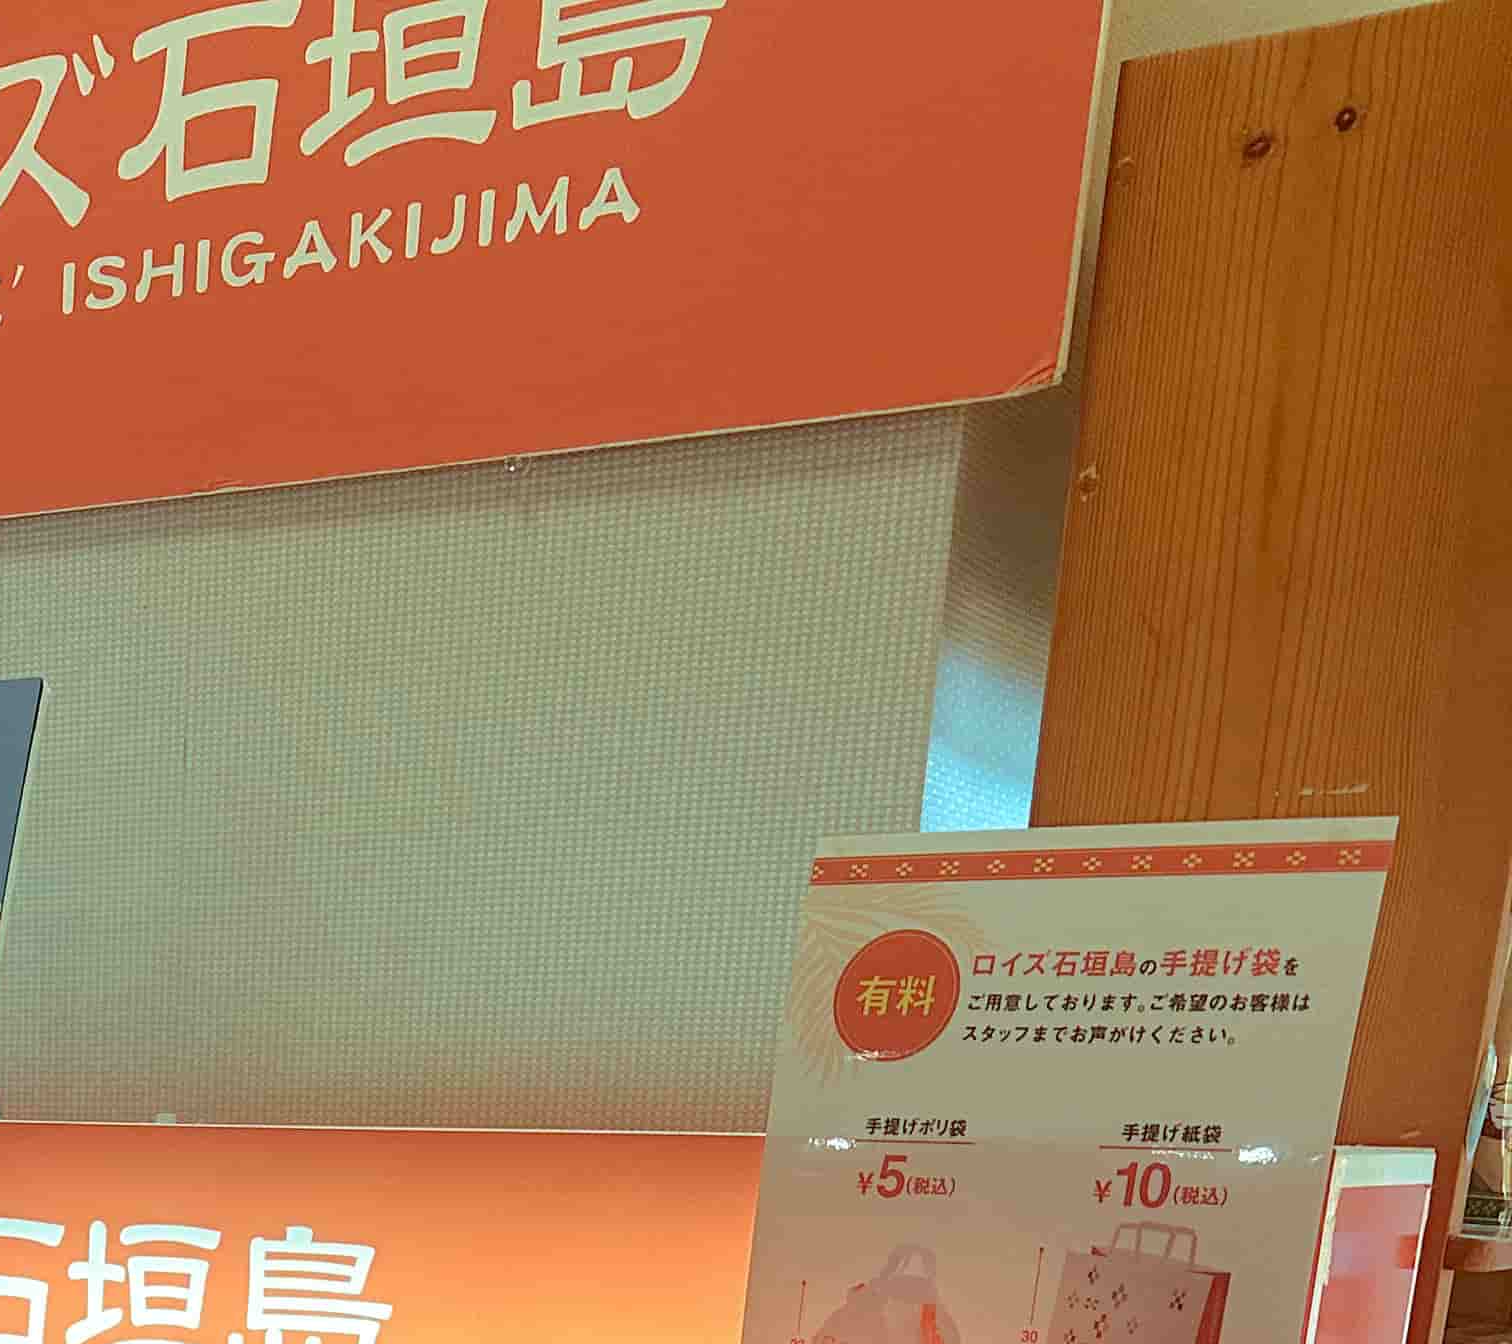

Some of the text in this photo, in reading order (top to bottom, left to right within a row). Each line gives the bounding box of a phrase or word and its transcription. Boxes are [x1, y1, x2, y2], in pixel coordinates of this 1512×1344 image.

[61, 166, 642, 315] ISHIGAKIJIMA
[971, 947, 1299, 978] ロイズ石垣島の手提げ袋を
[857, 976, 936, 1017] 有料
[962, 1022, 1236, 1046] スタッフまでお声がけください。
[865, 1117, 969, 1138] 手提げポリ袋
[1122, 1123, 1224, 1145] 手提げ紙袋
[1020, 1330, 1038, 1343] 30
